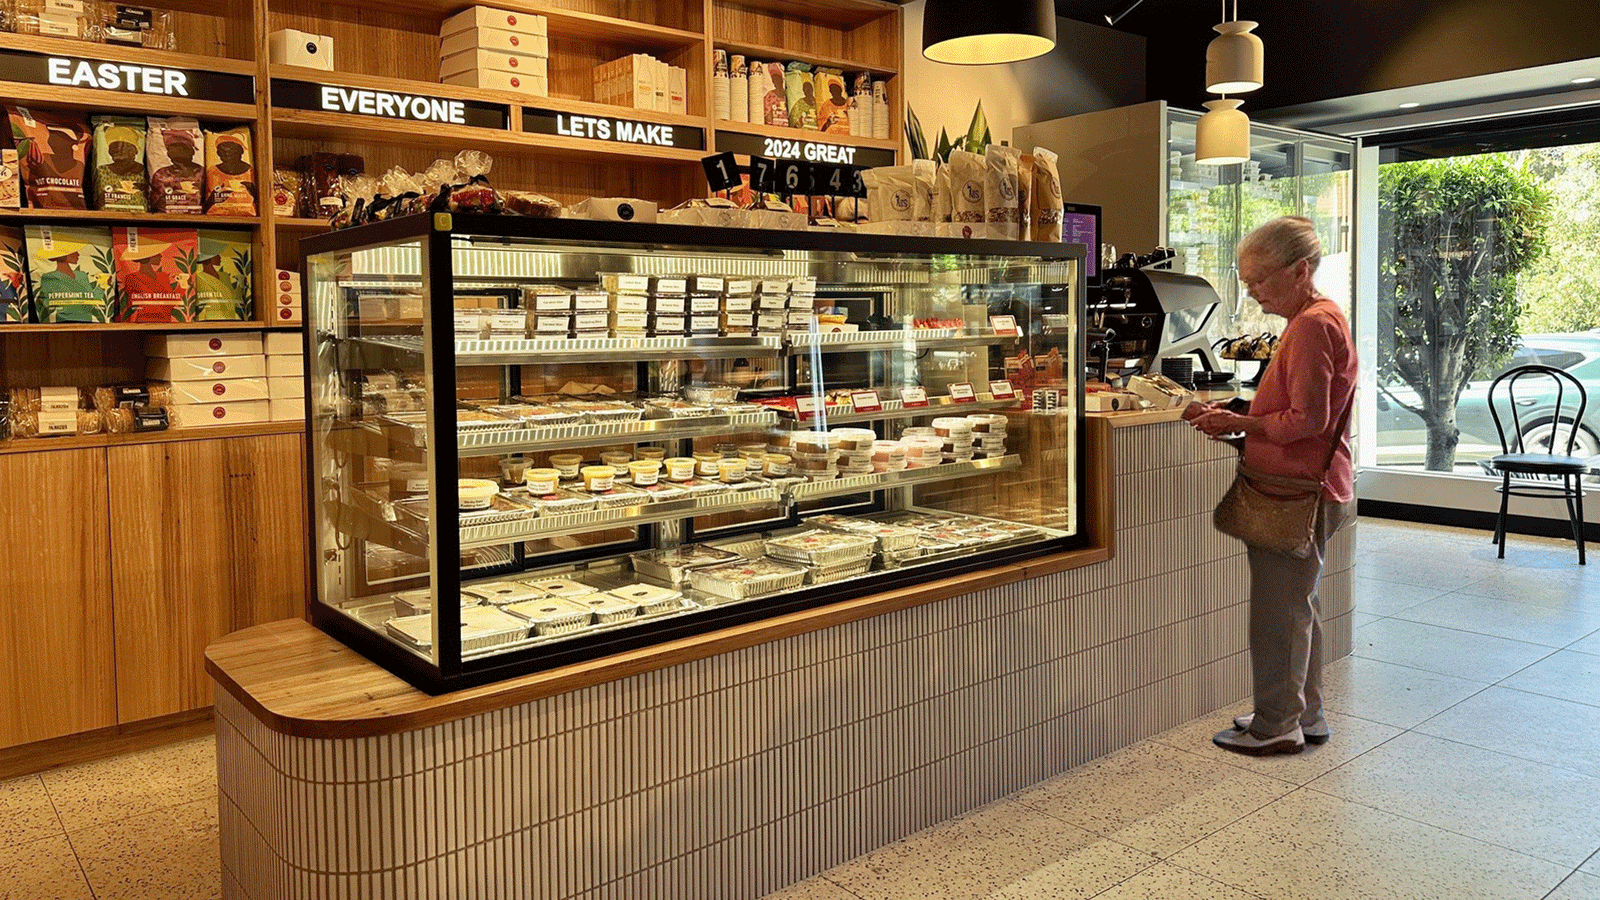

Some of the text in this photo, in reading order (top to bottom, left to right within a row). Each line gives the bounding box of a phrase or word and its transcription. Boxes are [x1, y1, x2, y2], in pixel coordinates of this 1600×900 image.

[48, 58, 189, 97] EASTER
[321, 86, 466, 124] EVERYONE
[557, 114, 674, 146] LETS MAKE
[764, 138, 857, 165] 2024 GREAT
[35, 177, 80, 187] HOT CHOCOLATE
[716, 159, 730, 184] 1
[757, 163, 768, 187] 7
[786, 165, 799, 189] 6
[829, 168, 841, 191] 4
[852, 170, 863, 193] 3
